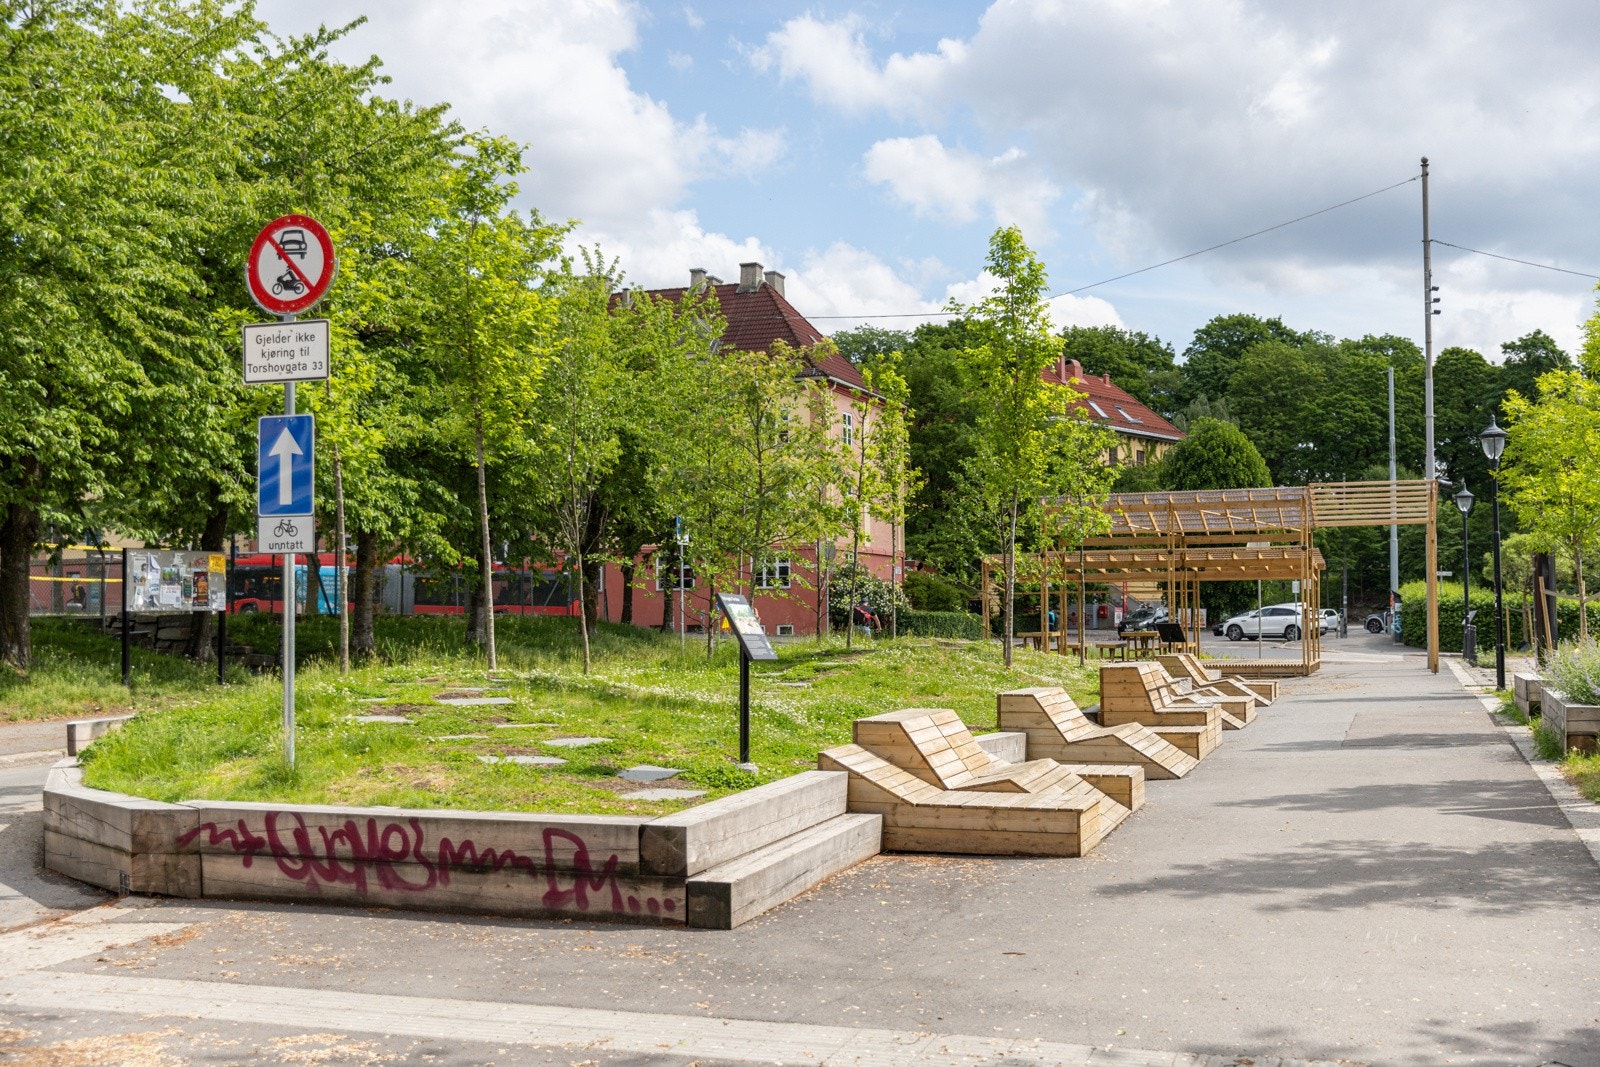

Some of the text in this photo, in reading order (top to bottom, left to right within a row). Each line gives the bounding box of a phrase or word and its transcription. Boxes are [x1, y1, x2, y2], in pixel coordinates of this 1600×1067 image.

[255, 332, 316, 347] Gjelder ikke
[261, 346, 310, 361] kjøring til
[247, 361, 323, 374] Torshovgata 33
[268, 540, 304, 550] unntatt
